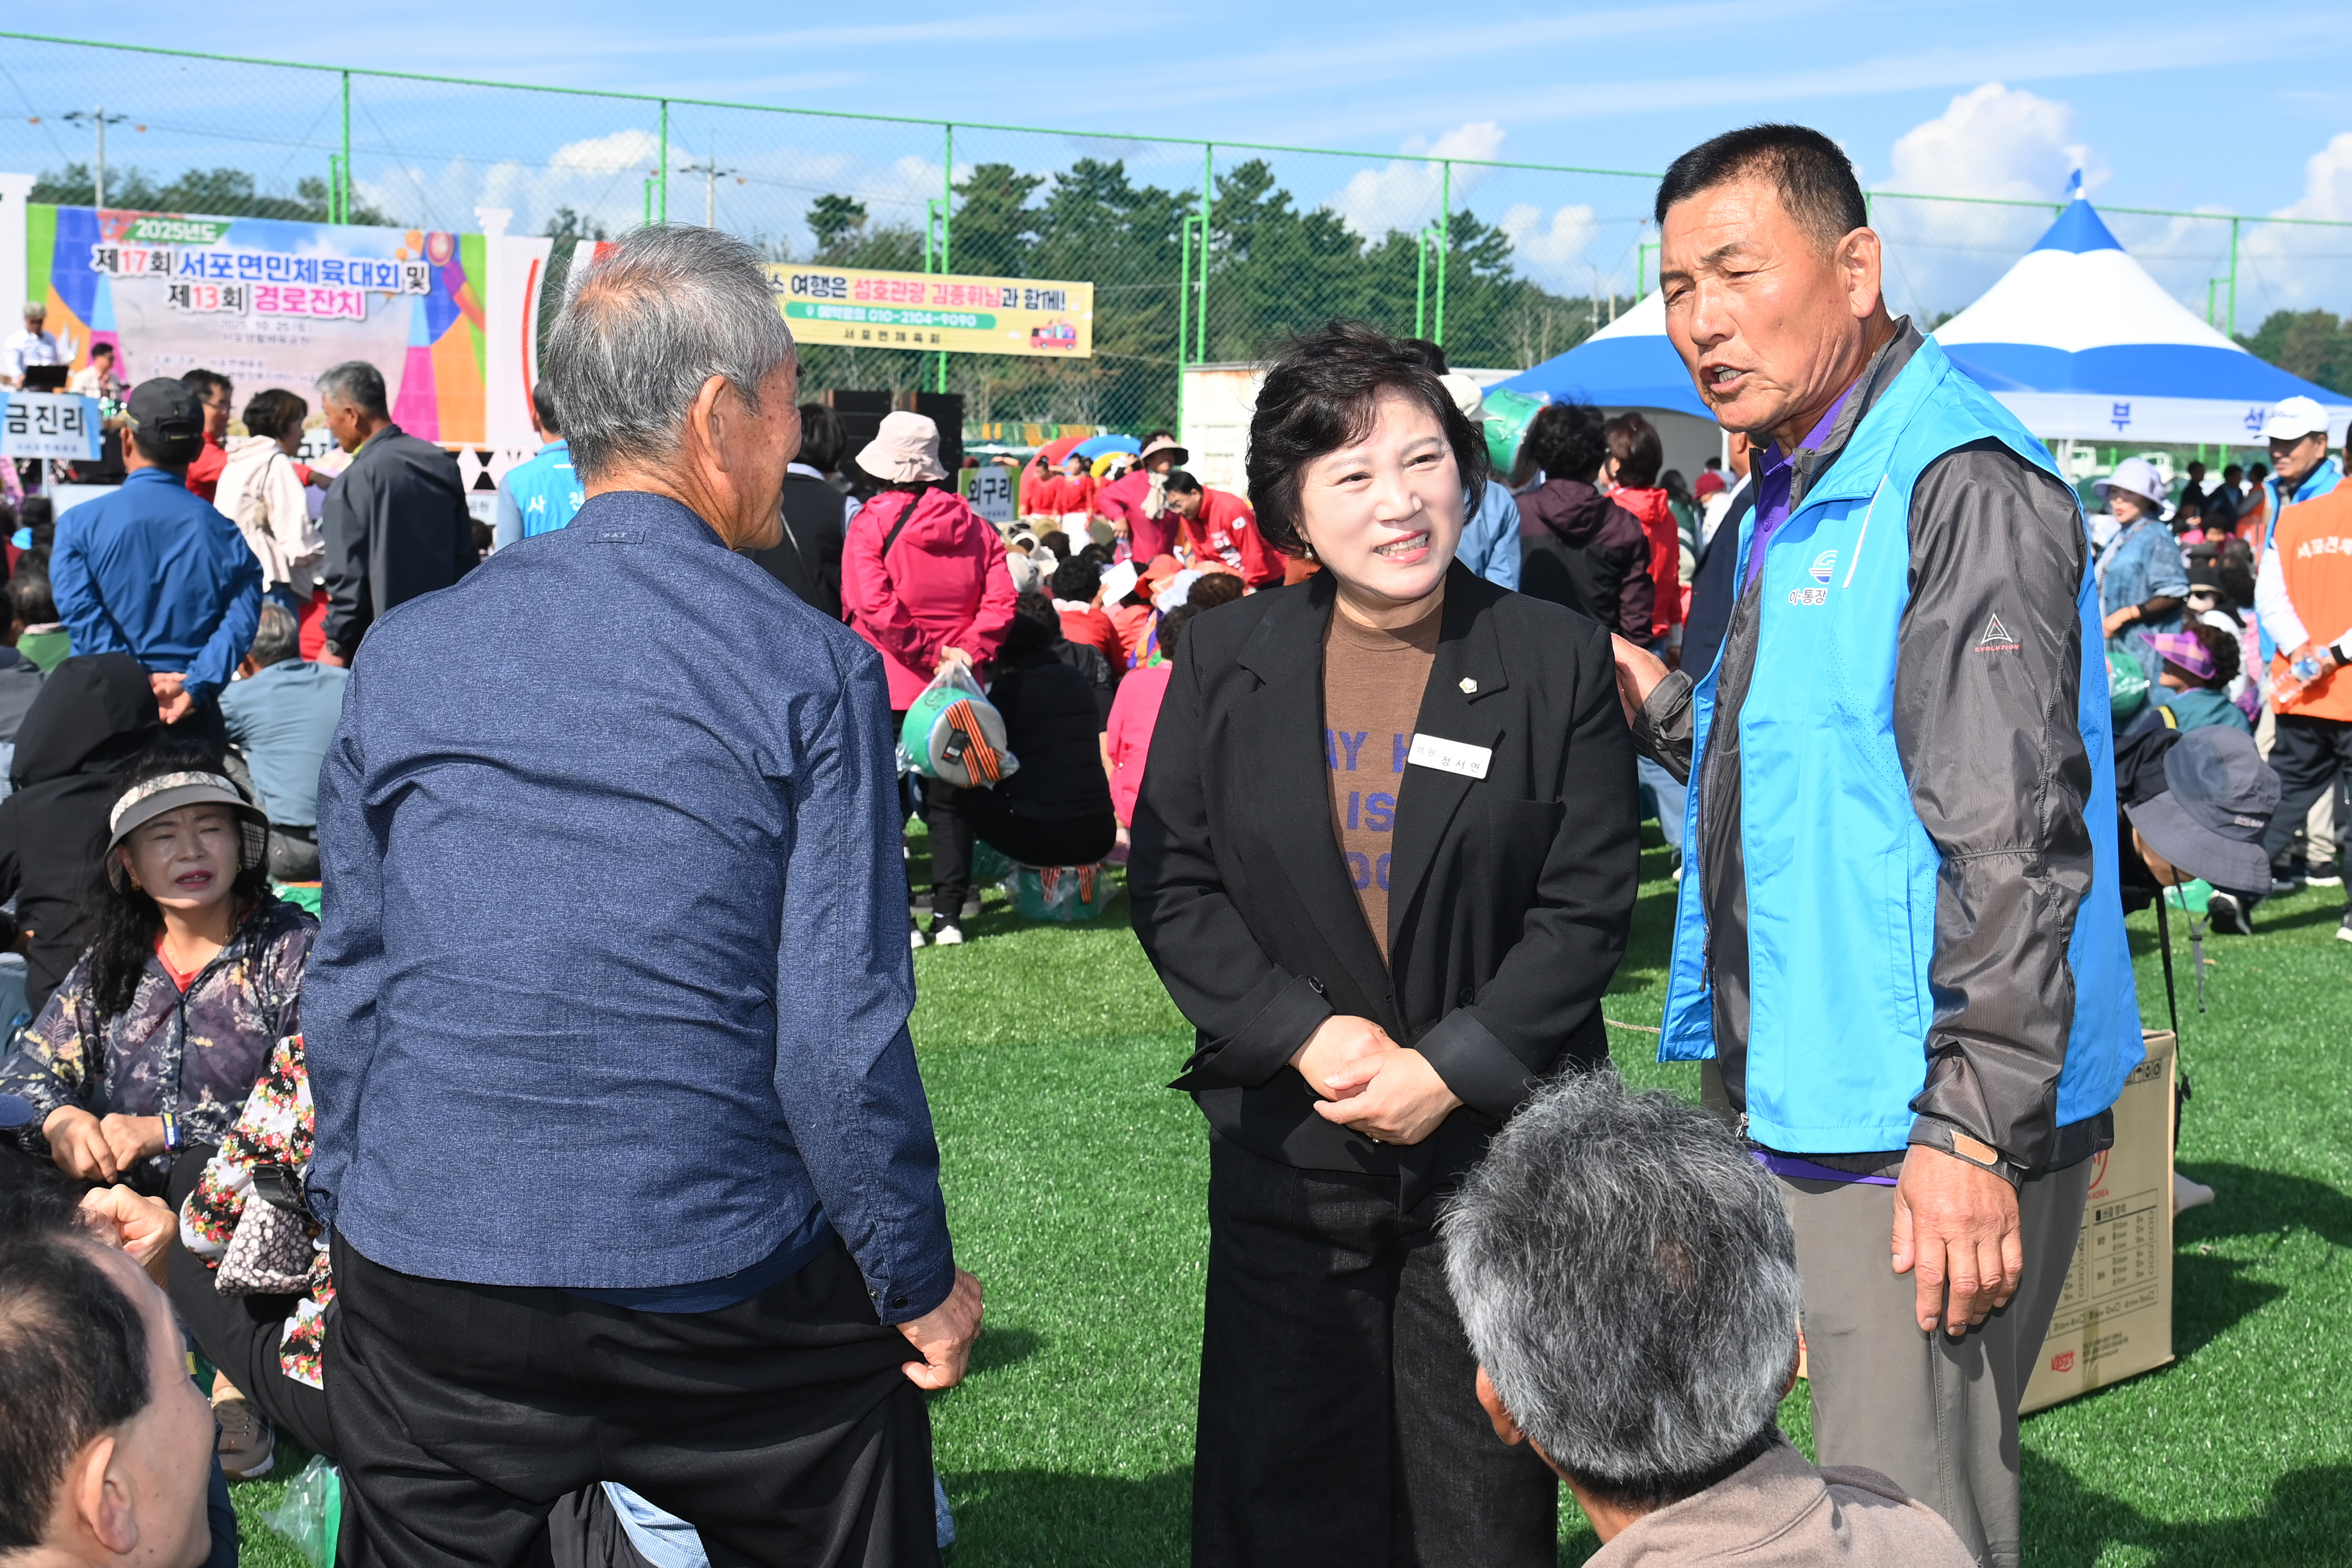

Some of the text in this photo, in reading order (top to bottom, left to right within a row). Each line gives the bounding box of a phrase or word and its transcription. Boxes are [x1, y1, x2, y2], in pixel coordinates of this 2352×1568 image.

[135, 219, 217, 242] 2025년도
[96, 248, 425, 290] 제17회 서포면민체육대회 및
[168, 284, 362, 317] 제13회 경로잔치
[791, 274, 848, 299] 여행은
[1024, 287, 1066, 311] 함께!
[868, 308, 977, 328] 010-2104-9090
[5, 403, 84, 436] 금진리
[968, 476, 1012, 505] 외구리
[1416, 746, 1480, 773] 의원 정서연
[1347, 791, 1396, 832] IS
